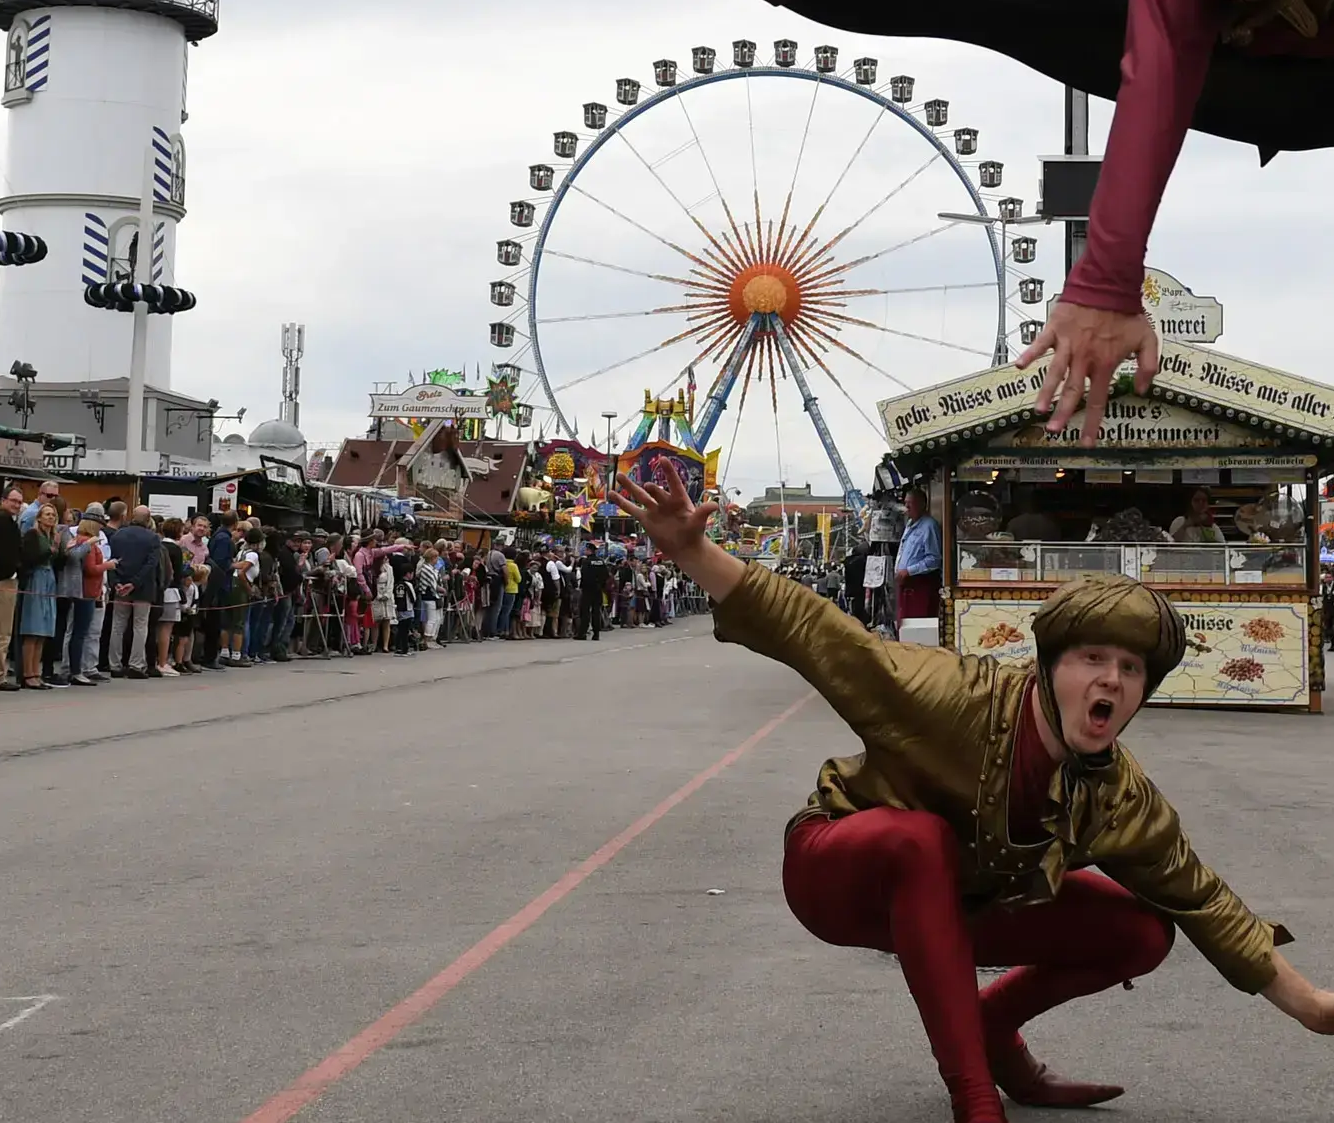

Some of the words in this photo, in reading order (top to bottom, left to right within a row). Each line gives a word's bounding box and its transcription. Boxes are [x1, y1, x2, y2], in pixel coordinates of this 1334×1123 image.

[1200, 362, 1254, 396] Nüsse
[1257, 384, 1288, 405] aus
[1291, 393, 1331, 418] aller
[377, 403, 399, 413] Zum
[894, 404, 937, 437] gebr.
[938, 388, 992, 417] Nüsse
[997, 378, 1027, 400] aus
[1045, 423, 1221, 442] Madelbrennerei
[1181, 614, 1234, 631] Nüsse
